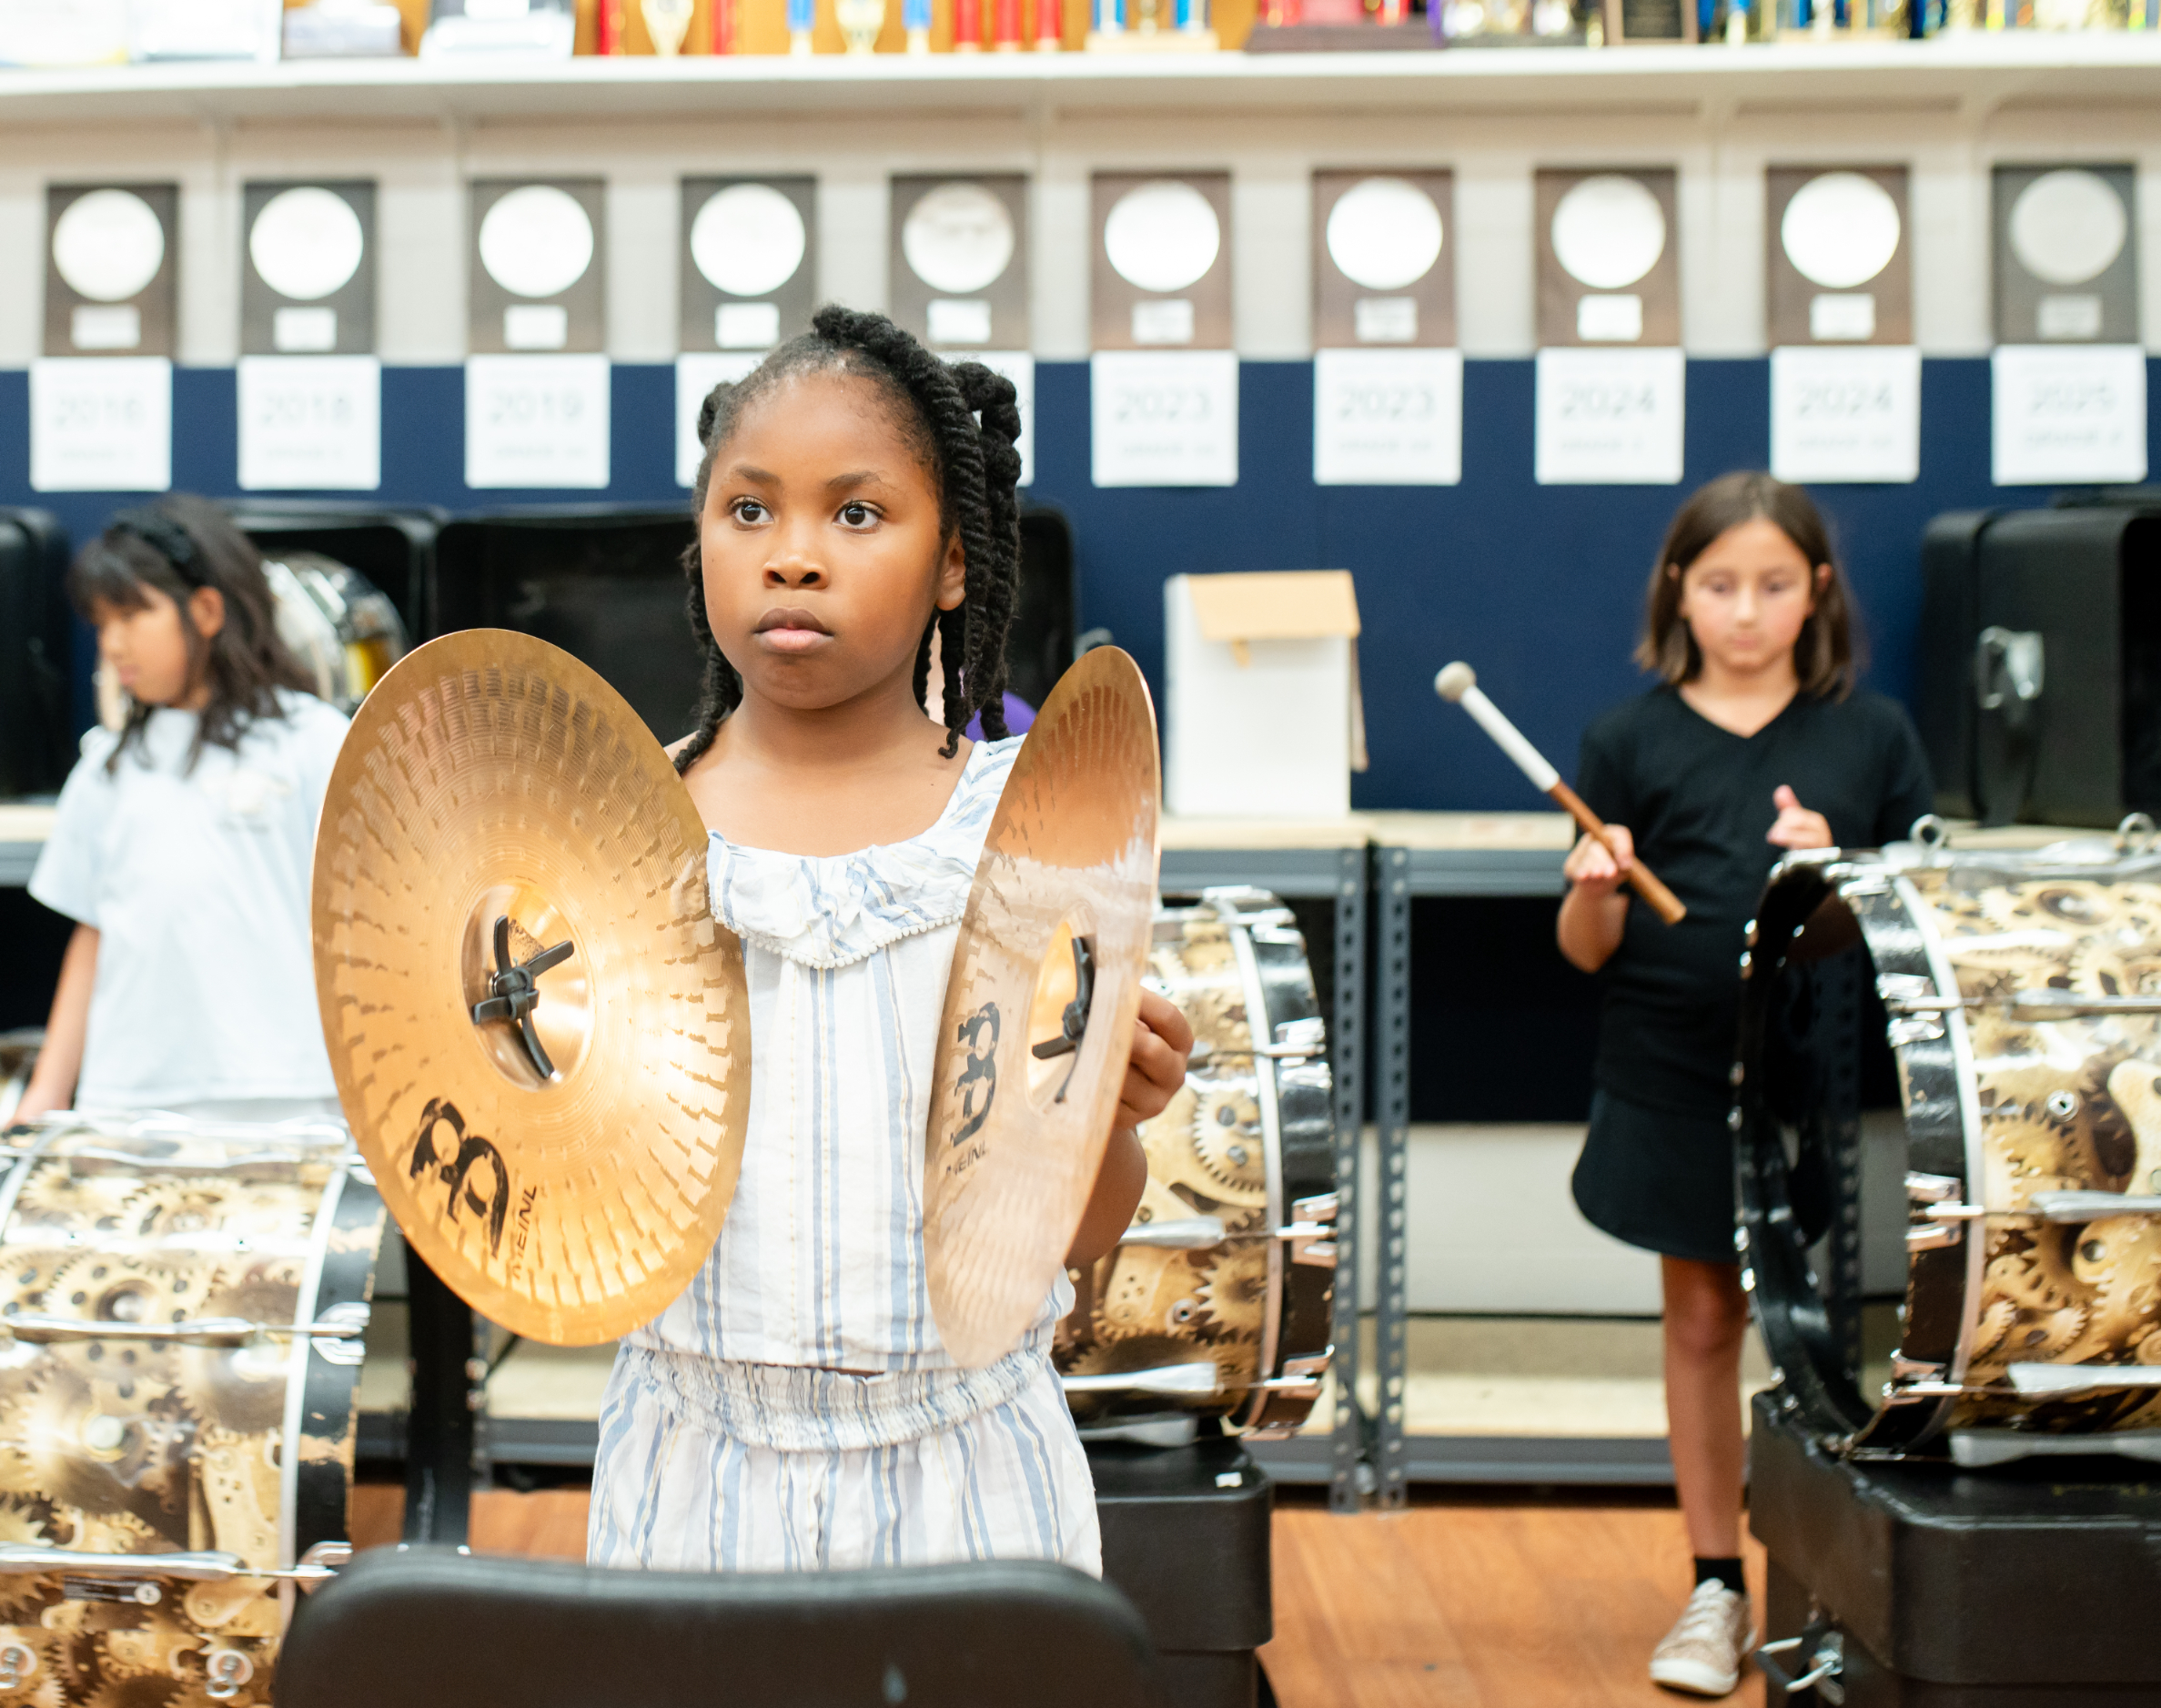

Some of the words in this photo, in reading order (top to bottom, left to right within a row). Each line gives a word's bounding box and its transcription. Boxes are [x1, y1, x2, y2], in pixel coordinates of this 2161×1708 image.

[488, 388, 583, 427] 2019
[1114, 384, 1212, 423] 2023
[1338, 383, 1436, 422] 2023
[1559, 381, 1657, 419] 2024
[1795, 380, 1893, 418] 2024
